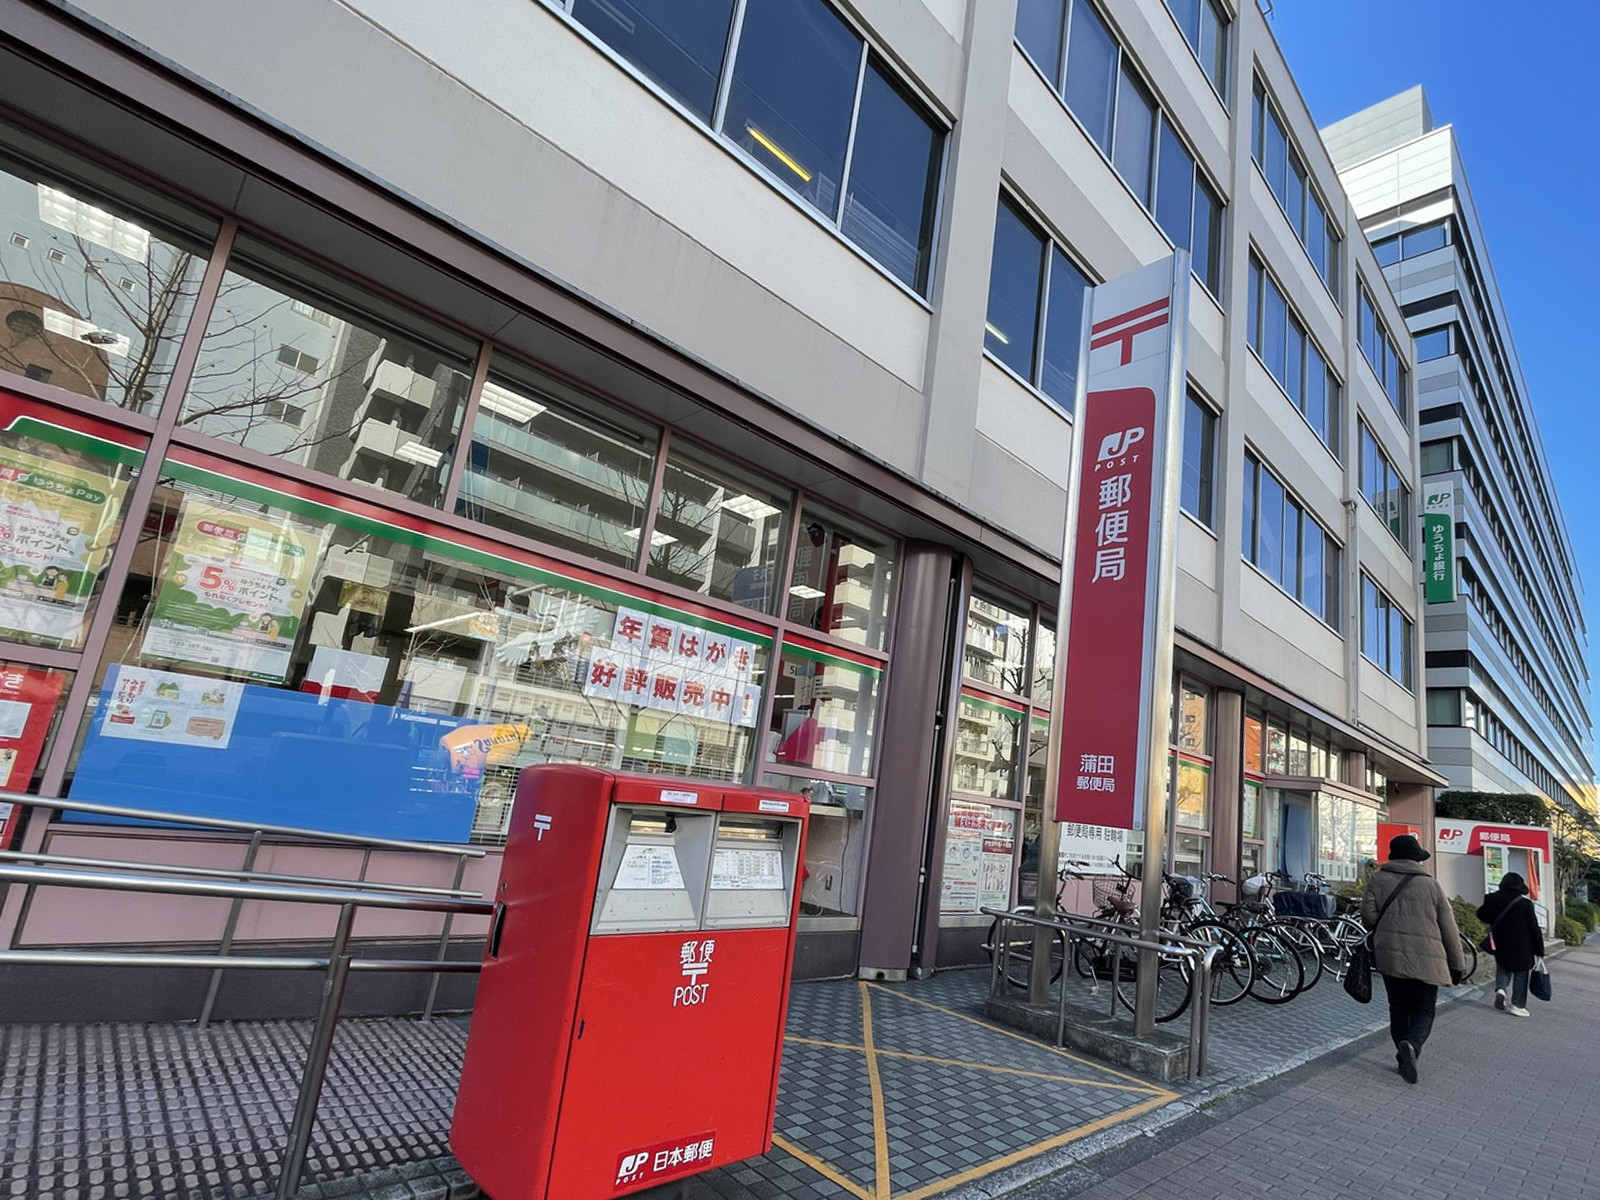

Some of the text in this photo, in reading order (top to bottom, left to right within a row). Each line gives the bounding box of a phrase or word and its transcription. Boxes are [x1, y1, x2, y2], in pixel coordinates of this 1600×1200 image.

[1094, 454, 1140, 472] POST
[1092, 473, 1133, 584] 郵便局
[1432, 524, 1446, 581] ゆうちょ銀行
[200, 566, 235, 592] 5%
[617, 616, 750, 671] 年賀はがき
[590, 659, 751, 716] 好評販売中!
[1080, 754, 1114, 774] 蒲田
[1076, 776, 1115, 792] 郵便局
[1479, 831, 1511, 843] 郵便局
[680, 939, 716, 965] 郵便
[672, 983, 710, 1007] POST
[653, 1138, 714, 1173] 日本郵便
[615, 1172, 644, 1186] POST
